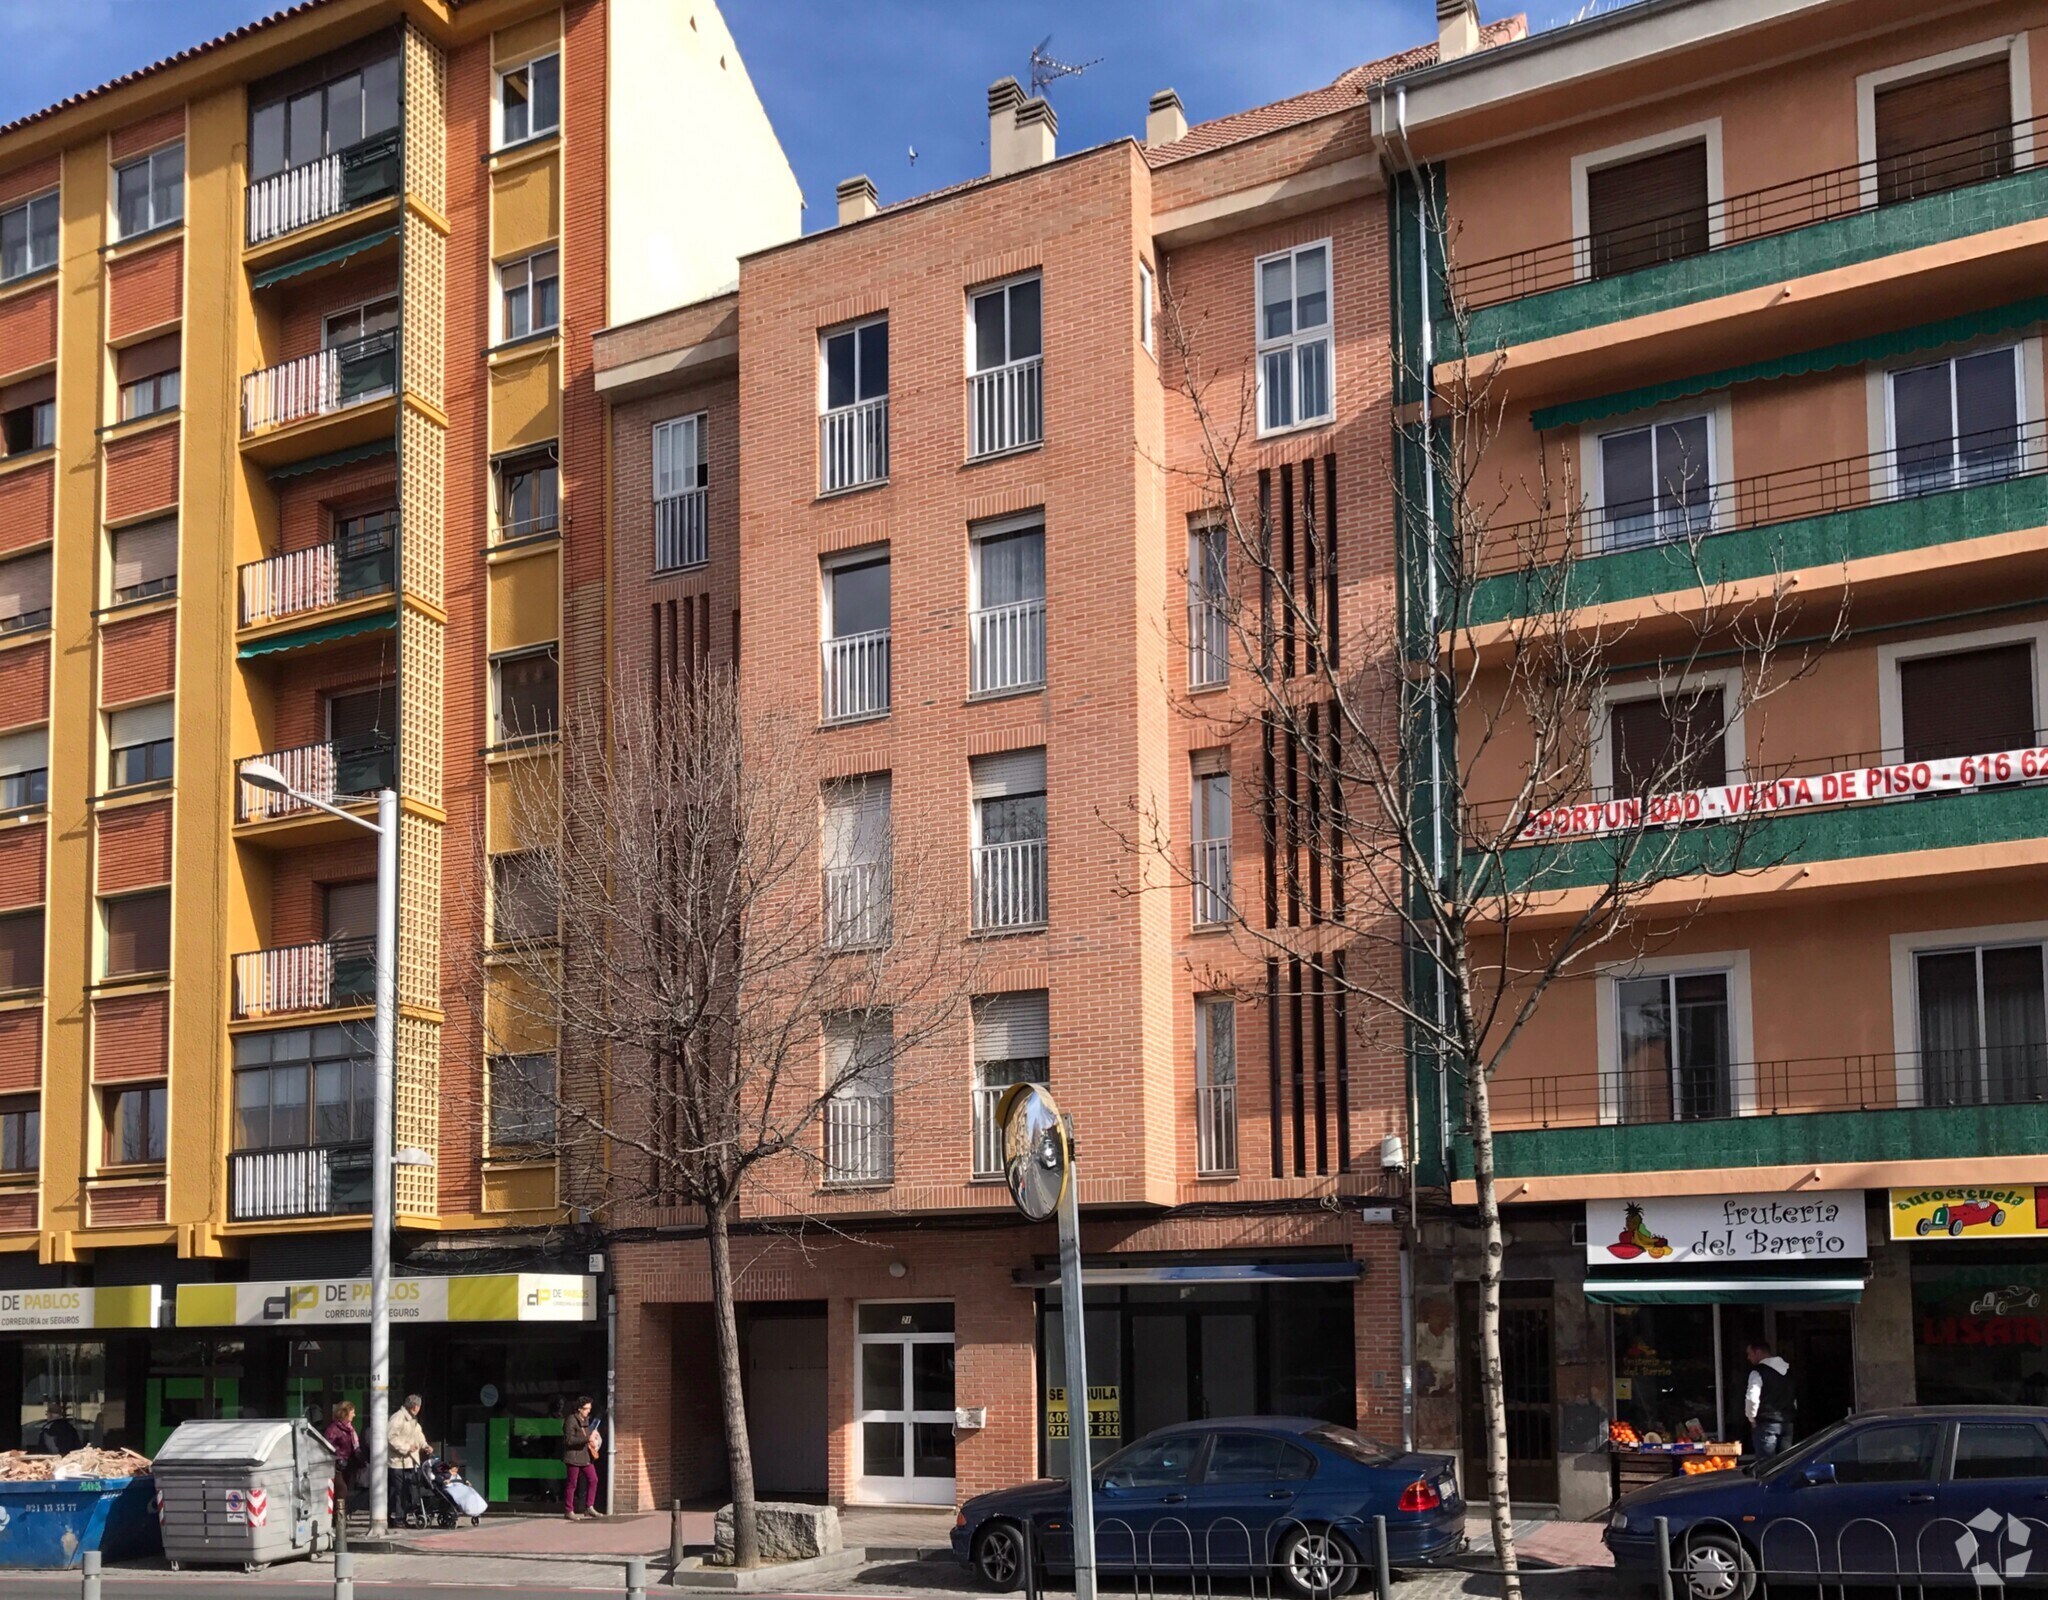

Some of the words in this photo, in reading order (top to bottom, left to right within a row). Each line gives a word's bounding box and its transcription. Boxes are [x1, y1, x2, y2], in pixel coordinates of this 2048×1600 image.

[1523, 793, 1700, 837] PORTUNDAD
[1725, 778, 1816, 814] VENTA
[1822, 771, 1856, 799] DE
[1867, 763, 1931, 796] PISO
[1960, 753, 2011, 785] 616
[1896, 1188, 2025, 1211] autoescuela
[1723, 1200, 1839, 1226] frutería
[1692, 1230, 1736, 1256] del
[1746, 1228, 1845, 1256] Barrio
[325, 1285, 347, 1302] DE
[352, 1282, 419, 1301] PAOS
[2, 1295, 20, 1311] DE
[24, 1292, 80, 1310] PABLOS
[50, 1316, 80, 1325] SEGUROS
[388, 1307, 420, 1318] EGUROS
[1049, 1388, 1064, 1401] SE
[1087, 1387, 1118, 1401] UILA
[1049, 1412, 1069, 1423] 609
[1098, 1411, 1119, 1423] 389
[1049, 1425, 1068, 1436] 921
[1098, 1425, 1119, 1436] 584
[67, 1503, 77, 1512] 77
